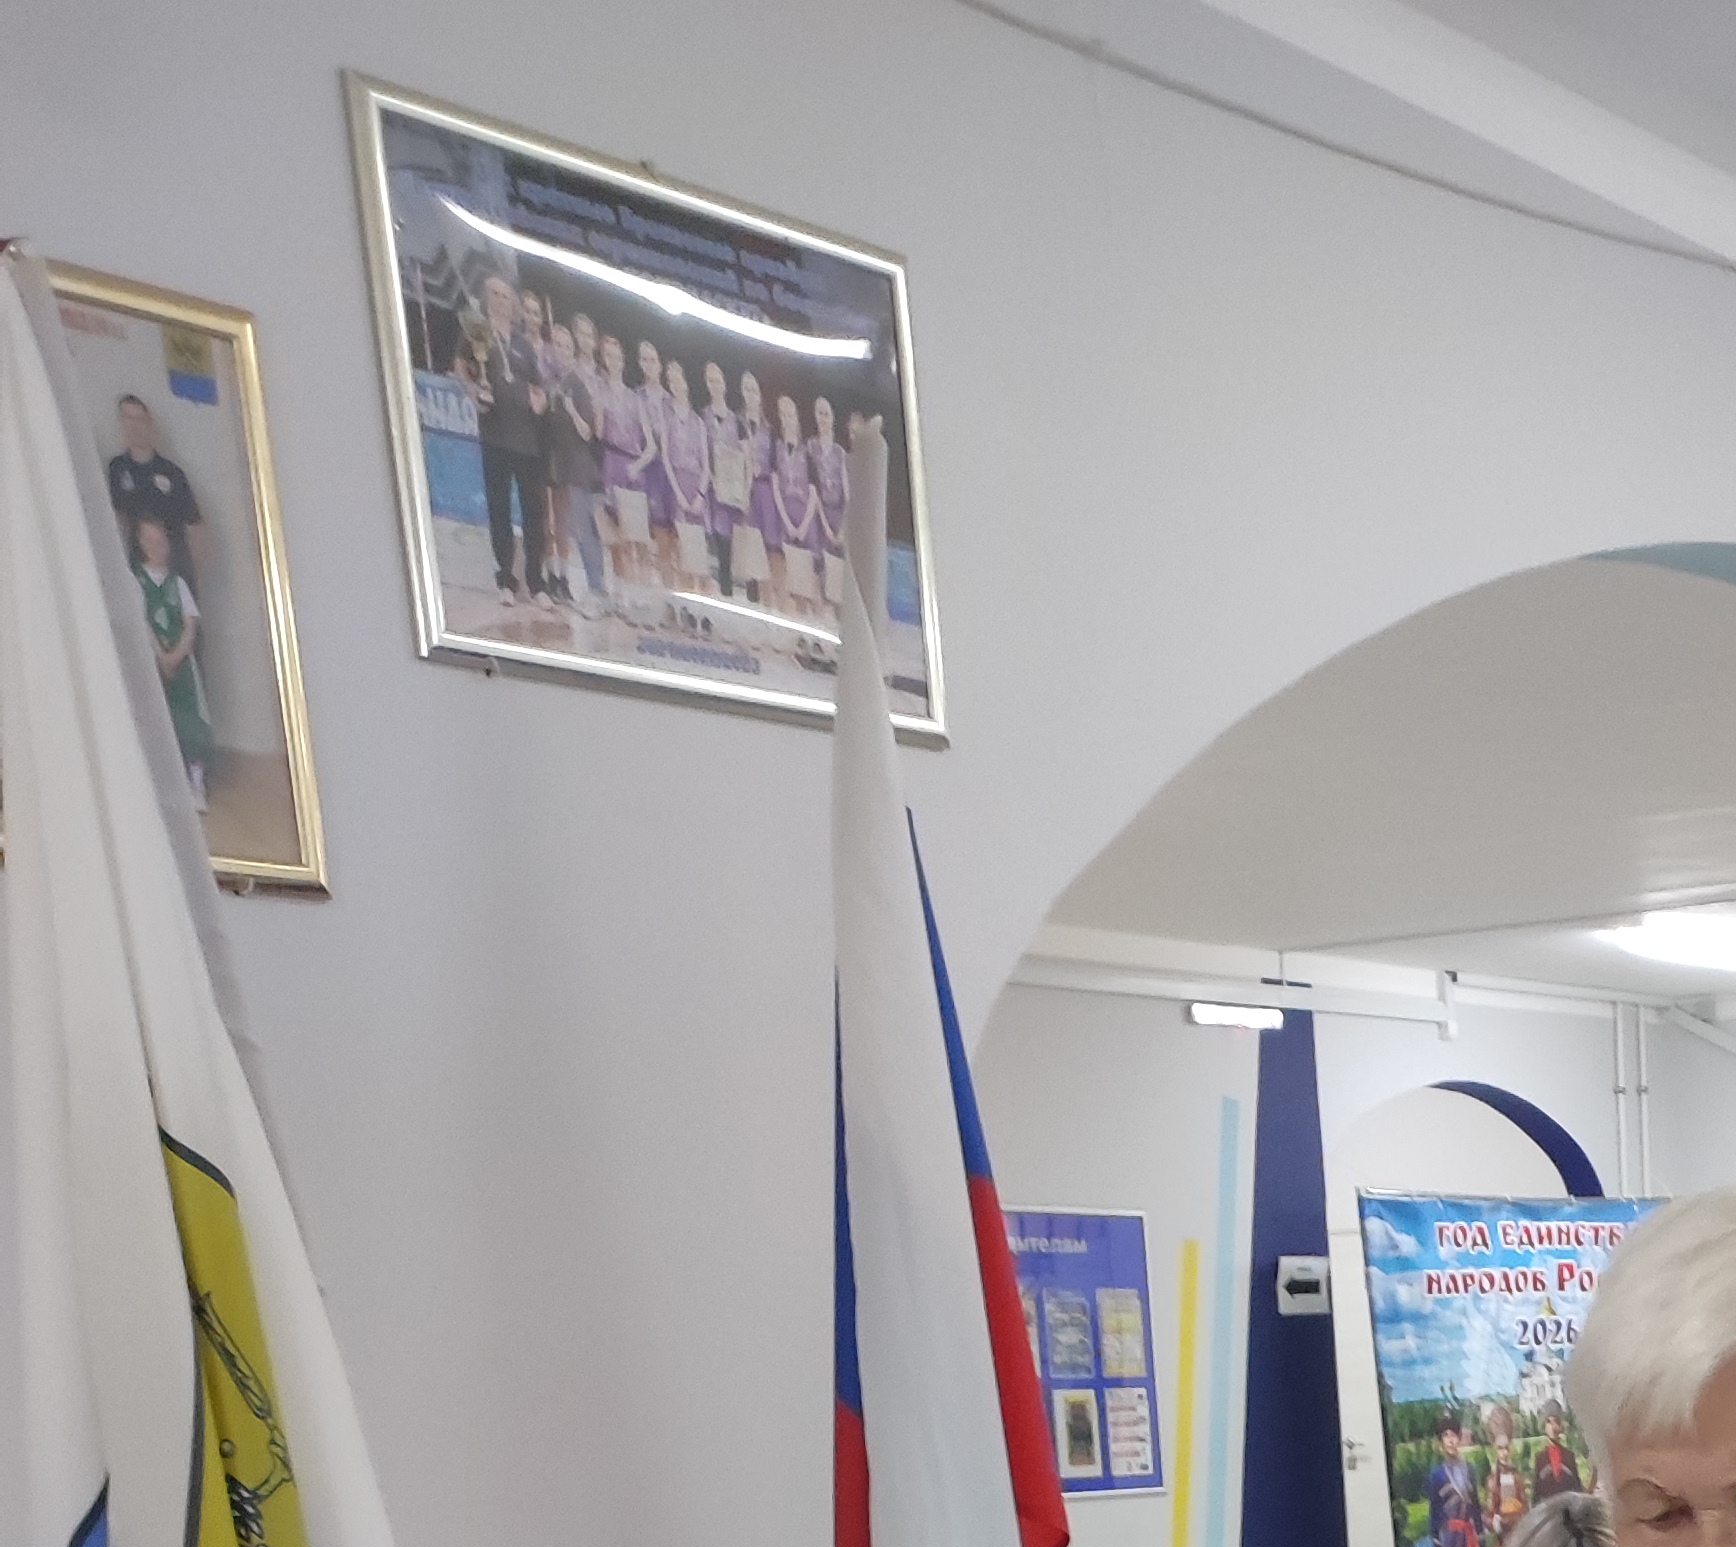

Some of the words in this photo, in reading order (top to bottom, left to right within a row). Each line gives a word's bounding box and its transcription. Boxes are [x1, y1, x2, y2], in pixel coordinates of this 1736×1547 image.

[1436, 1222, 1491, 1251] ГОД
[1500, 1222, 1624, 1251] ЕДИНСТВ
[1426, 1269, 1547, 1295] НАРОДОВ
